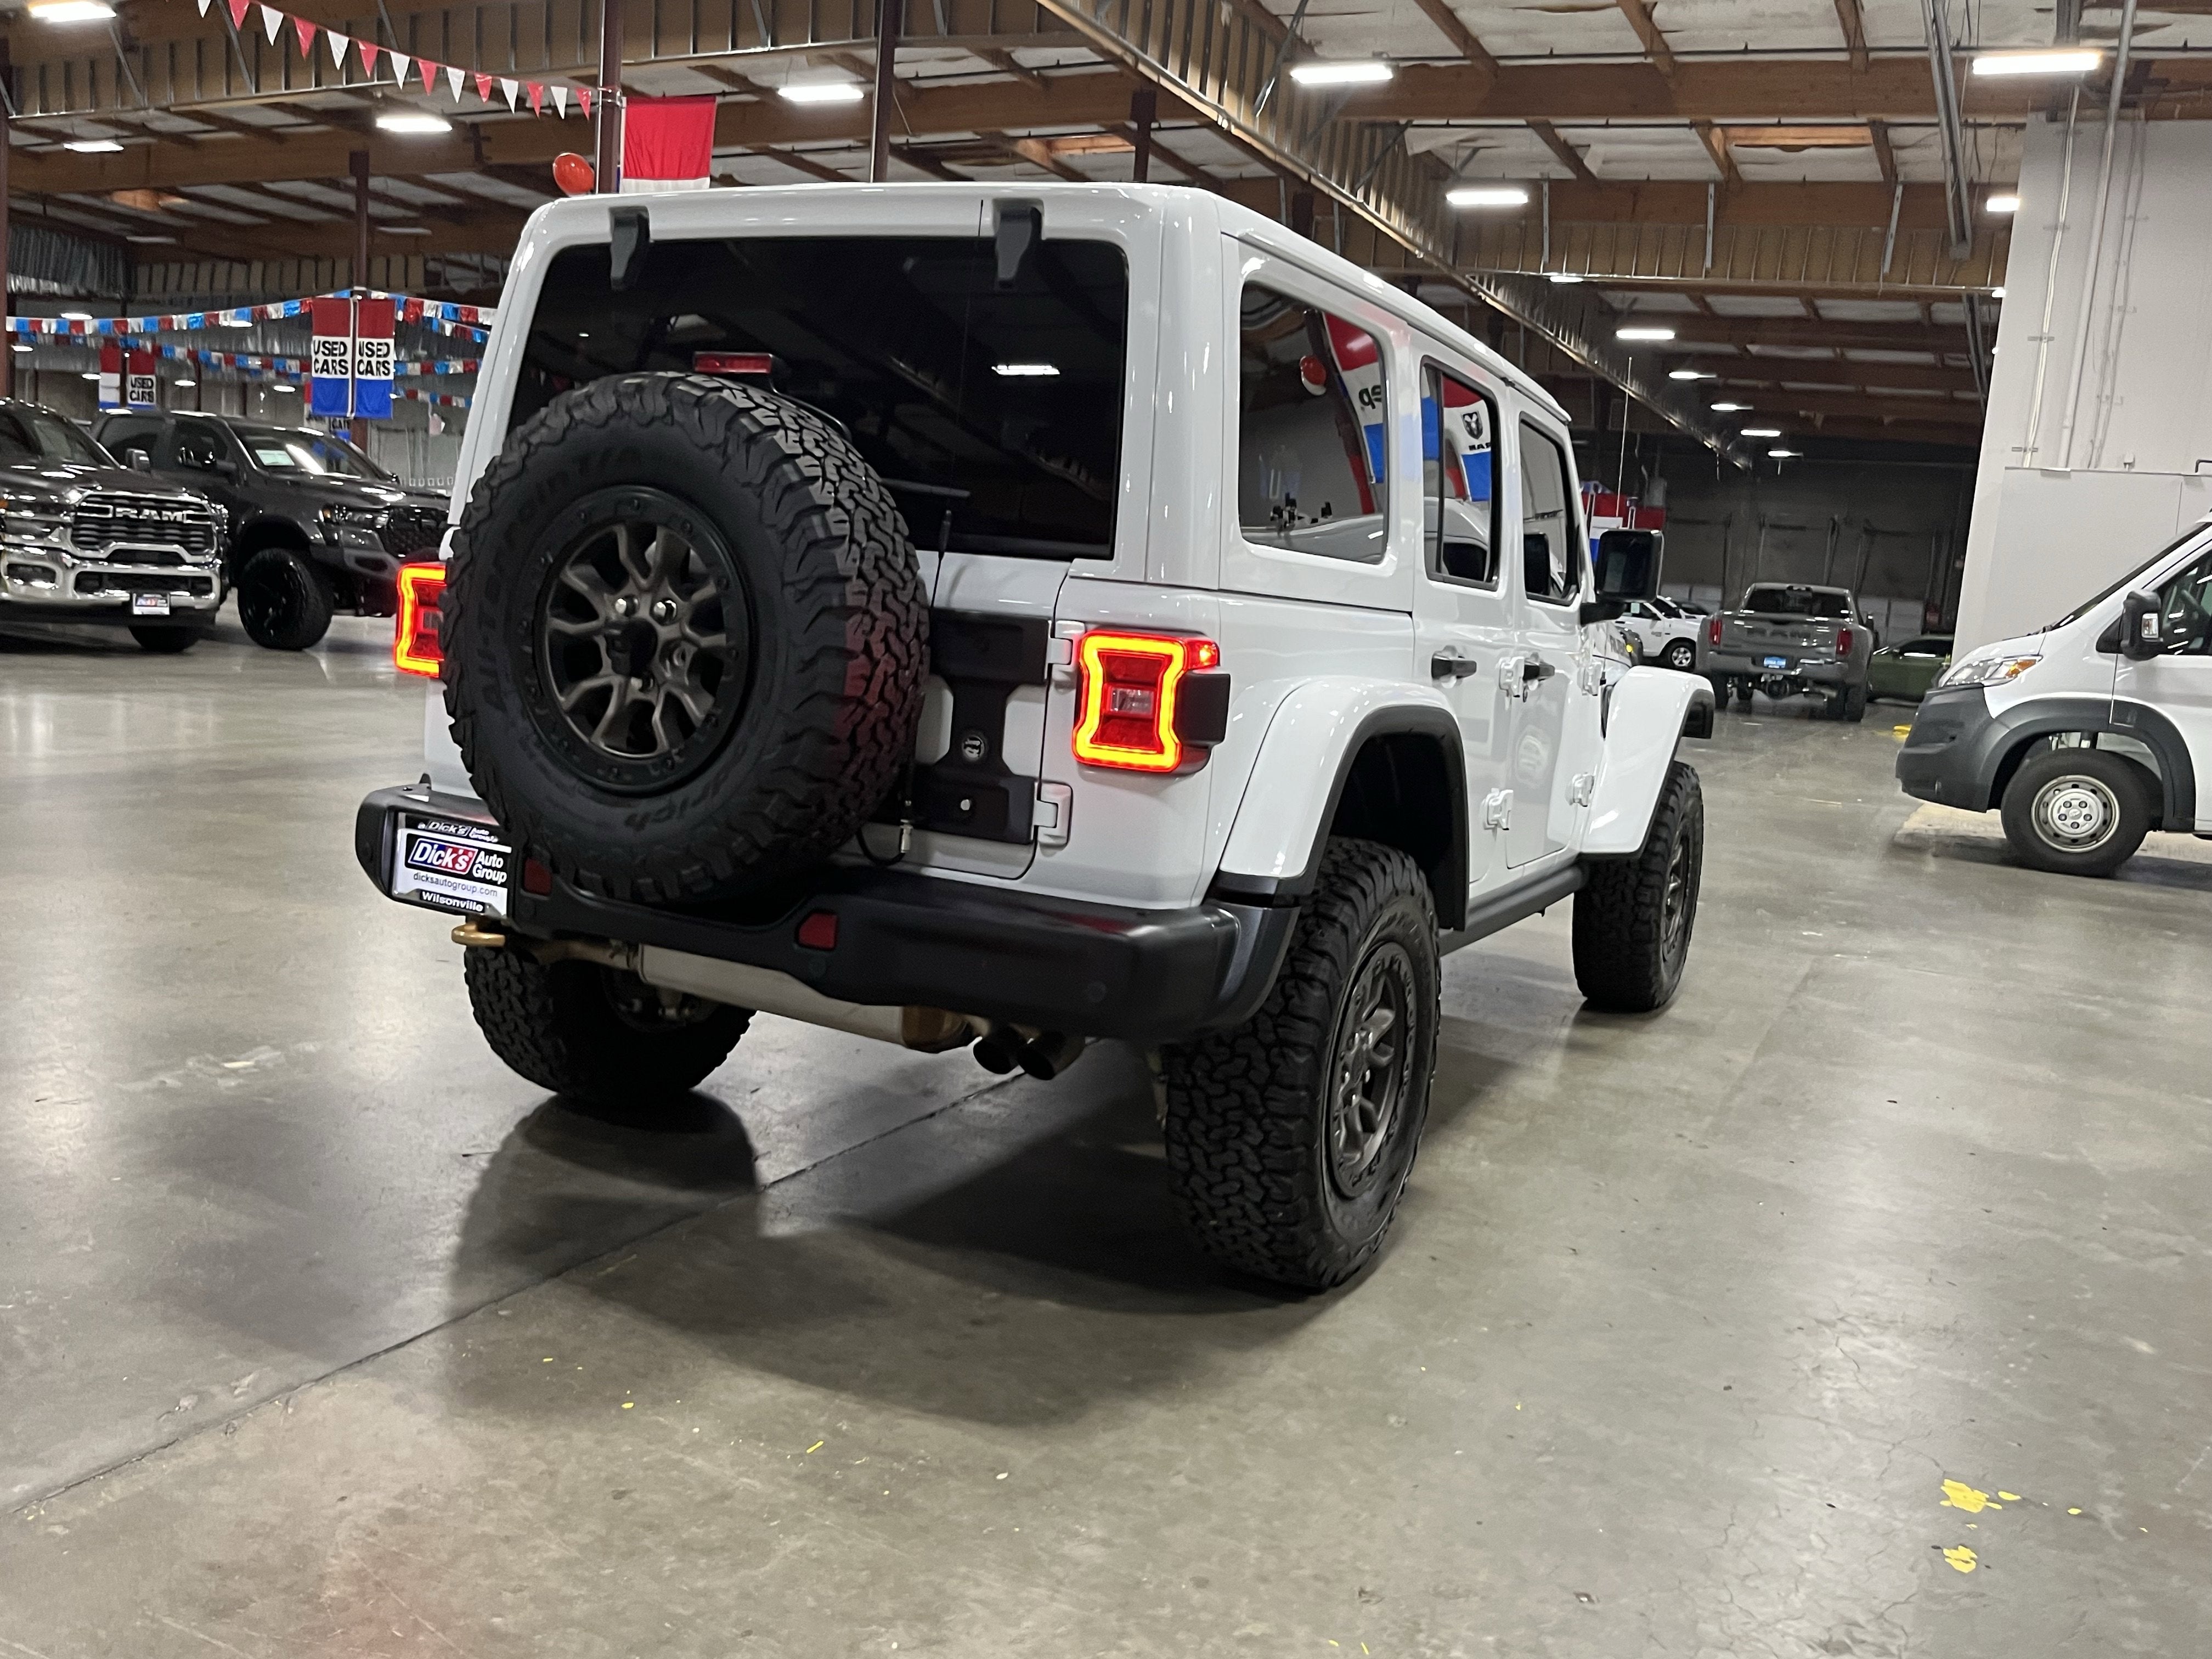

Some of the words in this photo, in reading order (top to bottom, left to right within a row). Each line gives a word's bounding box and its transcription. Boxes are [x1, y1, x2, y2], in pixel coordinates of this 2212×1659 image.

[313, 340, 348, 357] USED
[358, 341, 391, 358] USED
[313, 359, 349, 375] CARS
[357, 359, 391, 376] CARS
[115, 507, 183, 522] RAM
[428, 822, 467, 834] Dick's
[413, 842, 470, 871] Dick's
[475, 851, 504, 868] Auto
[472, 864, 507, 884] Group
[413, 872, 498, 897] dicksautogroup.com
[422, 891, 484, 912] Wilsonville
